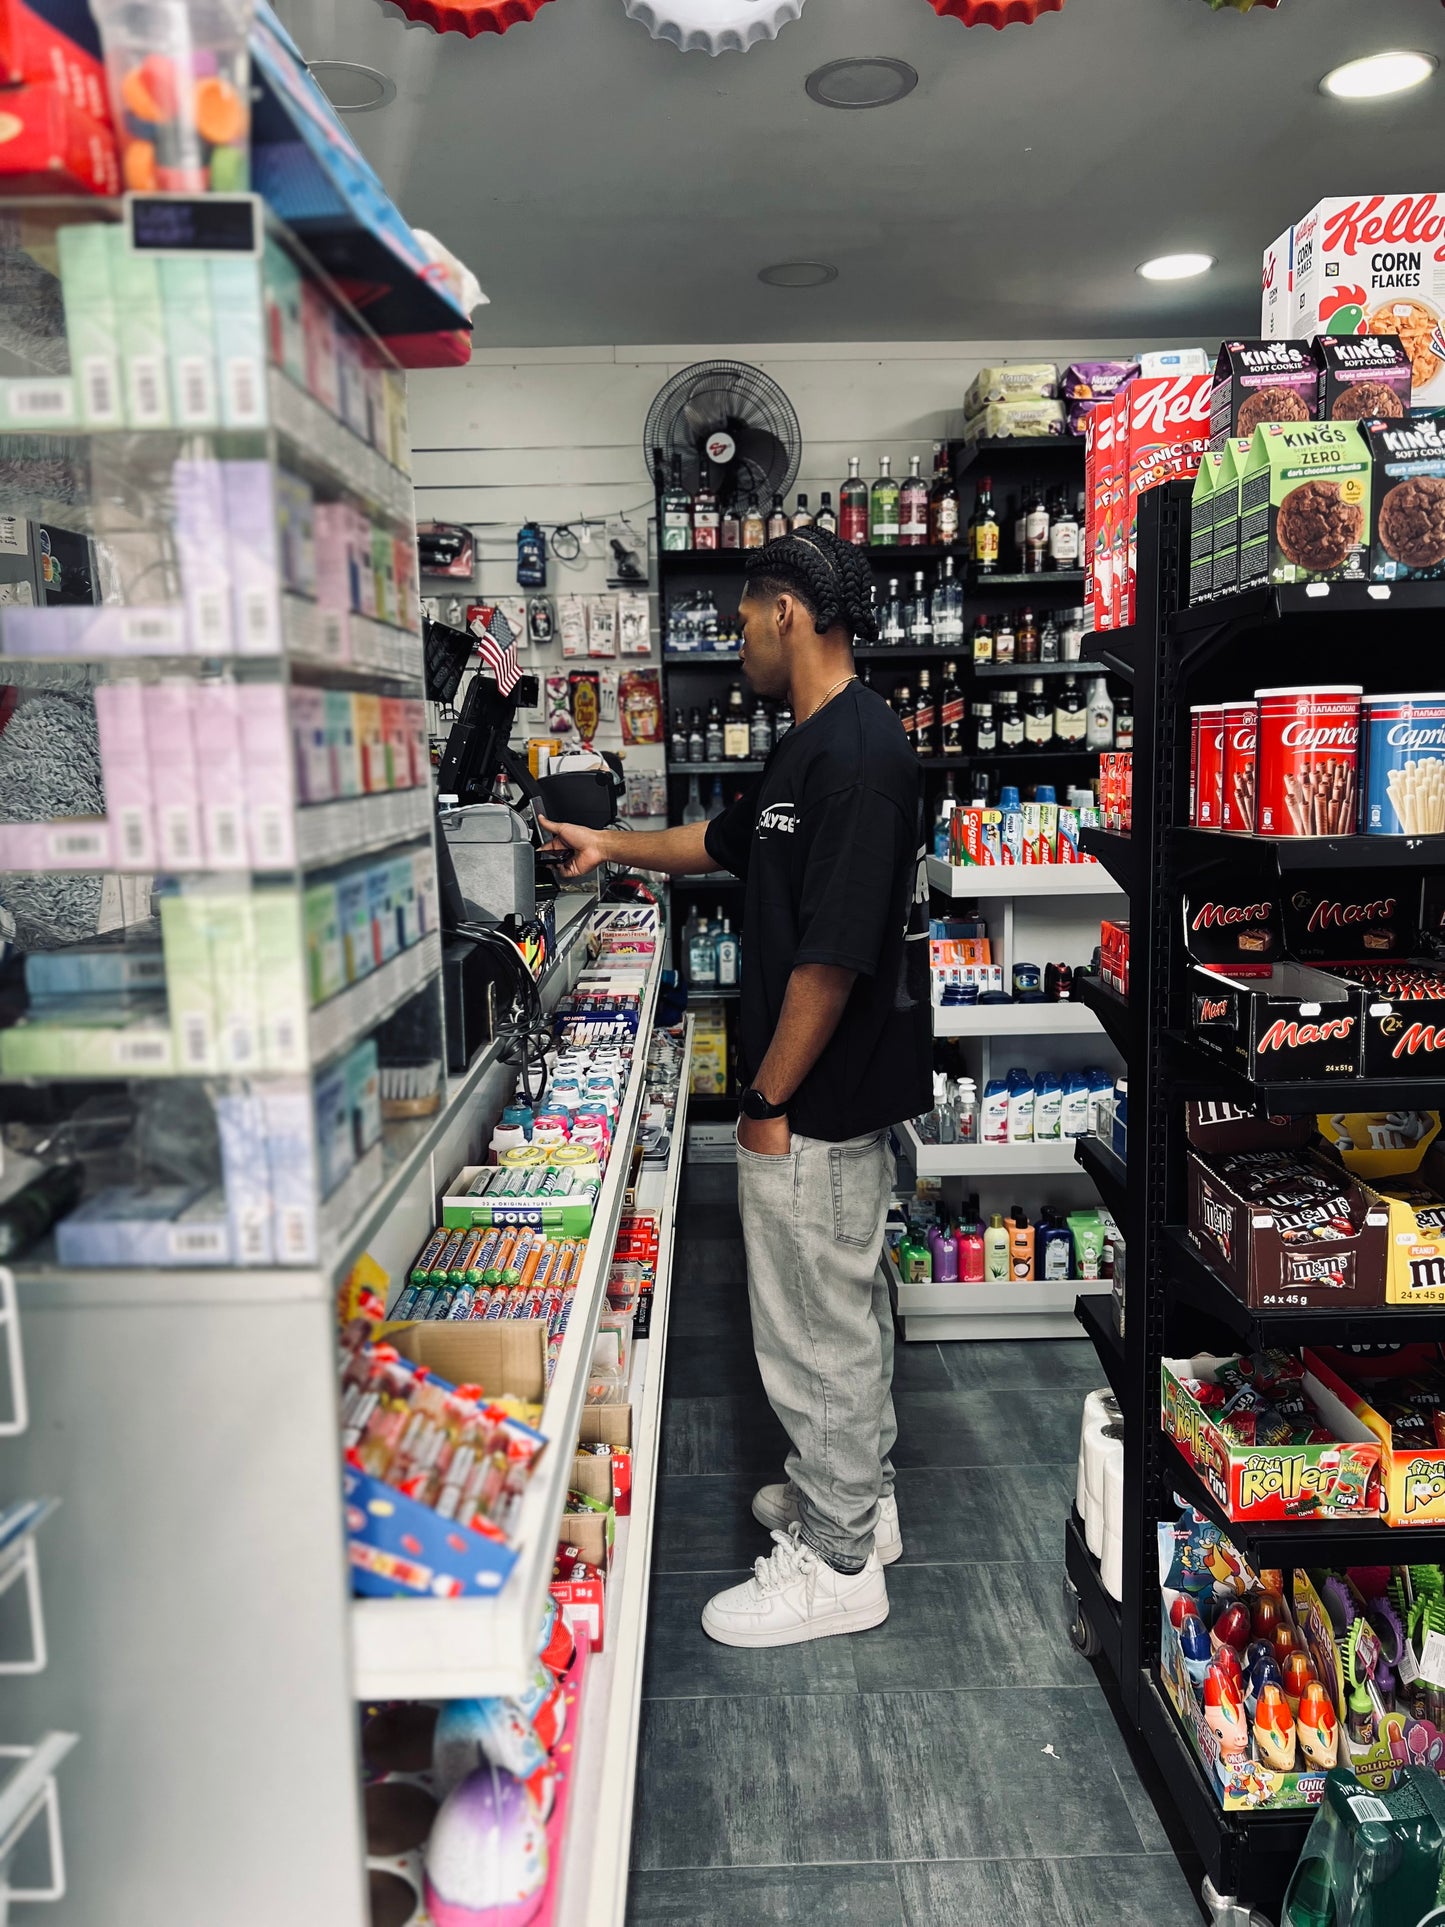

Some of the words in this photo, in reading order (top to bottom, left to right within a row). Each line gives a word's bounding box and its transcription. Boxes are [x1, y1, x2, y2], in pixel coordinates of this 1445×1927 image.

[1297, 239, 1313, 266] CORN
[1297, 260, 1312, 280] FLAKES
[1371, 252, 1421, 273] CORN
[1371, 273, 1420, 289] FLAKES
[1240, 349, 1301, 366] KINGS
[1334, 343, 1395, 360] KINGS
[1250, 364, 1276, 373] SOFT
[1277, 362, 1303, 372] COOKIE
[1344, 358, 1366, 367] SOFT
[1366, 357, 1397, 366] COOKIE
[1283, 429, 1347, 448] KINGS
[1301, 450, 1341, 464] ZERO
[1395, 450, 1418, 459] SOFT
[1303, 465, 1337, 477] chocolate
[1338, 463, 1361, 473] chunks
[1281, 720, 1358, 750] Caprice
[967, 812, 979, 856] Colgate
[1192, 902, 1272, 931] Mars
[1307, 898, 1396, 933] Mars
[1201, 998, 1227, 1023] Mars
[1386, 1016, 1403, 1032] 2x
[1257, 1016, 1354, 1054] Mars
[493, 1212, 541, 1223] POLO
[1411, 1246, 1436, 1255] PEANUT
[1263, 1294, 1276, 1305] 24
[1278, 1296, 1285, 1304] x
[1286, 1294, 1299, 1304] 45
[1300, 1296, 1307, 1306] g
[1401, 1290, 1412, 1299] 24
[1424, 1290, 1436, 1299] 45
[1246, 1455, 1280, 1471] fini
[1241, 1455, 1339, 1507] Roller
[1321, 1506, 1336, 1515] 40
[1410, 1517, 1434, 1526] Longest
